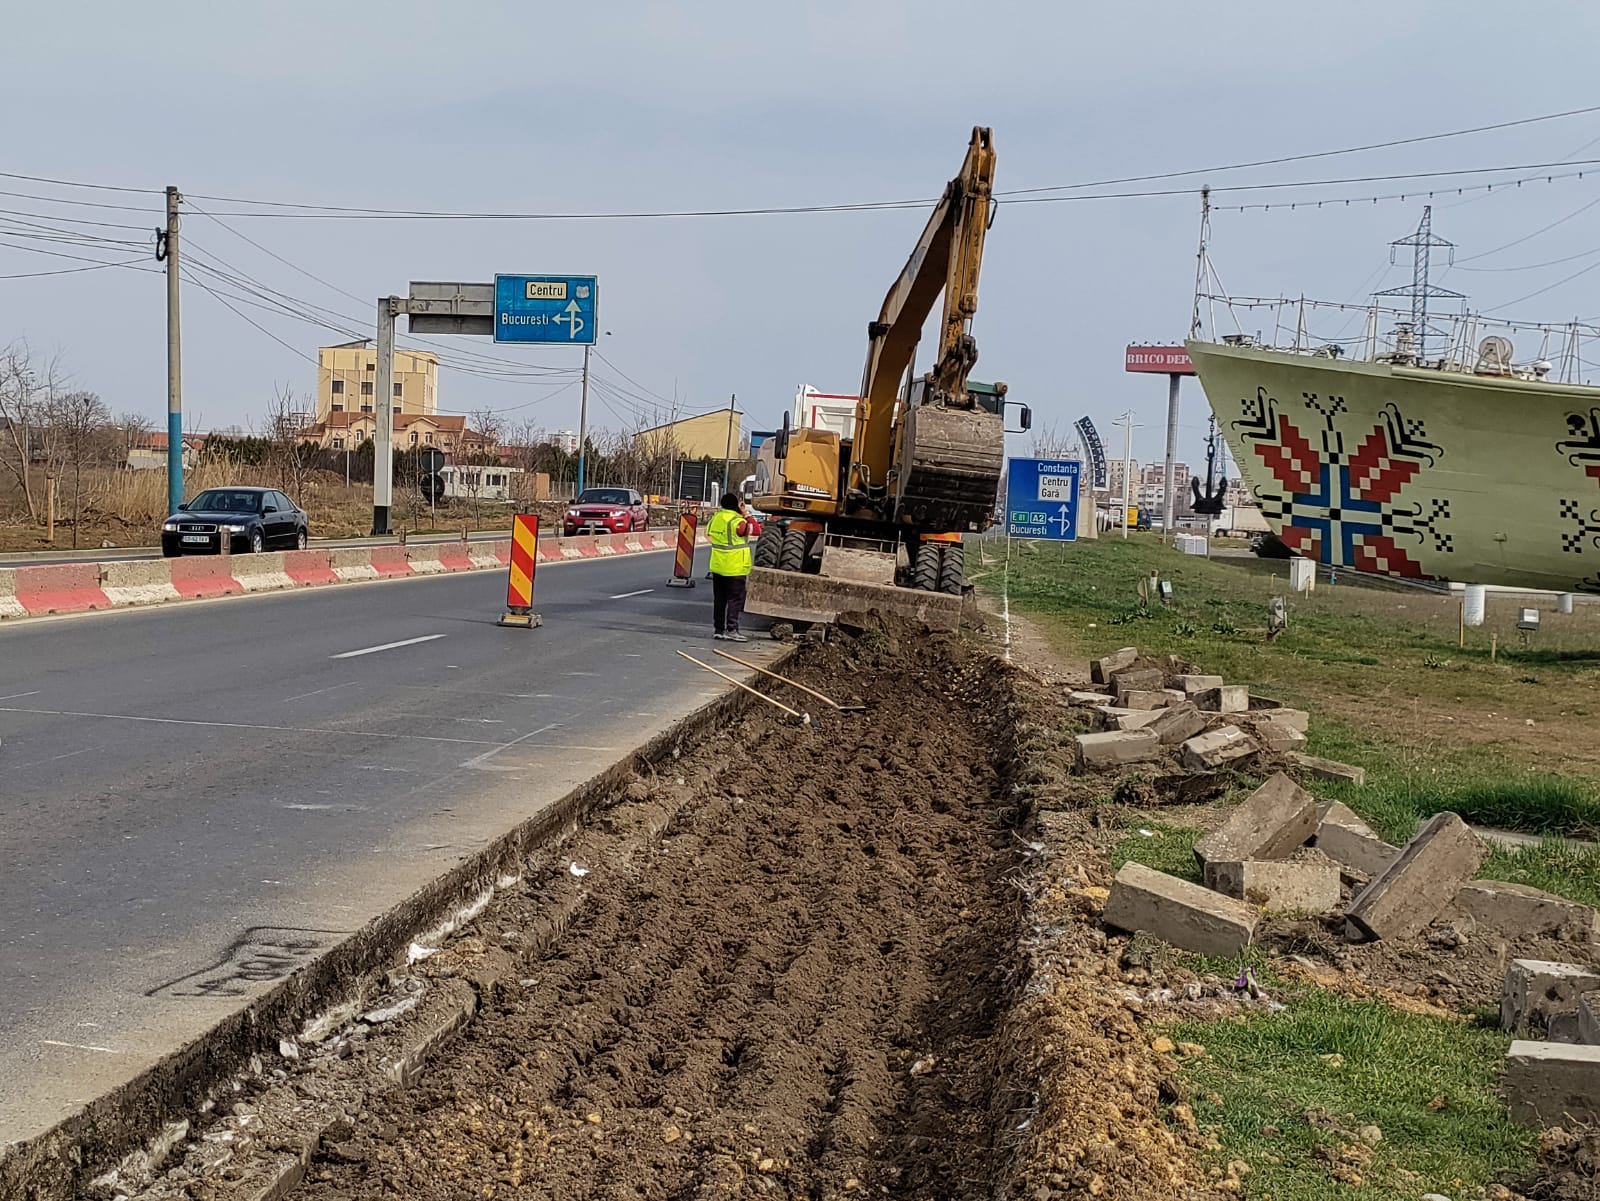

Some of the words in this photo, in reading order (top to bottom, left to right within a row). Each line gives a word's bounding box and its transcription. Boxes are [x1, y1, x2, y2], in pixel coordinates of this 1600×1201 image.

[530, 284, 563, 296] Centru
[1127, 353, 1164, 364] BRICO
[1042, 476, 1069, 487] Centru
[1032, 514, 1045, 522] A2
